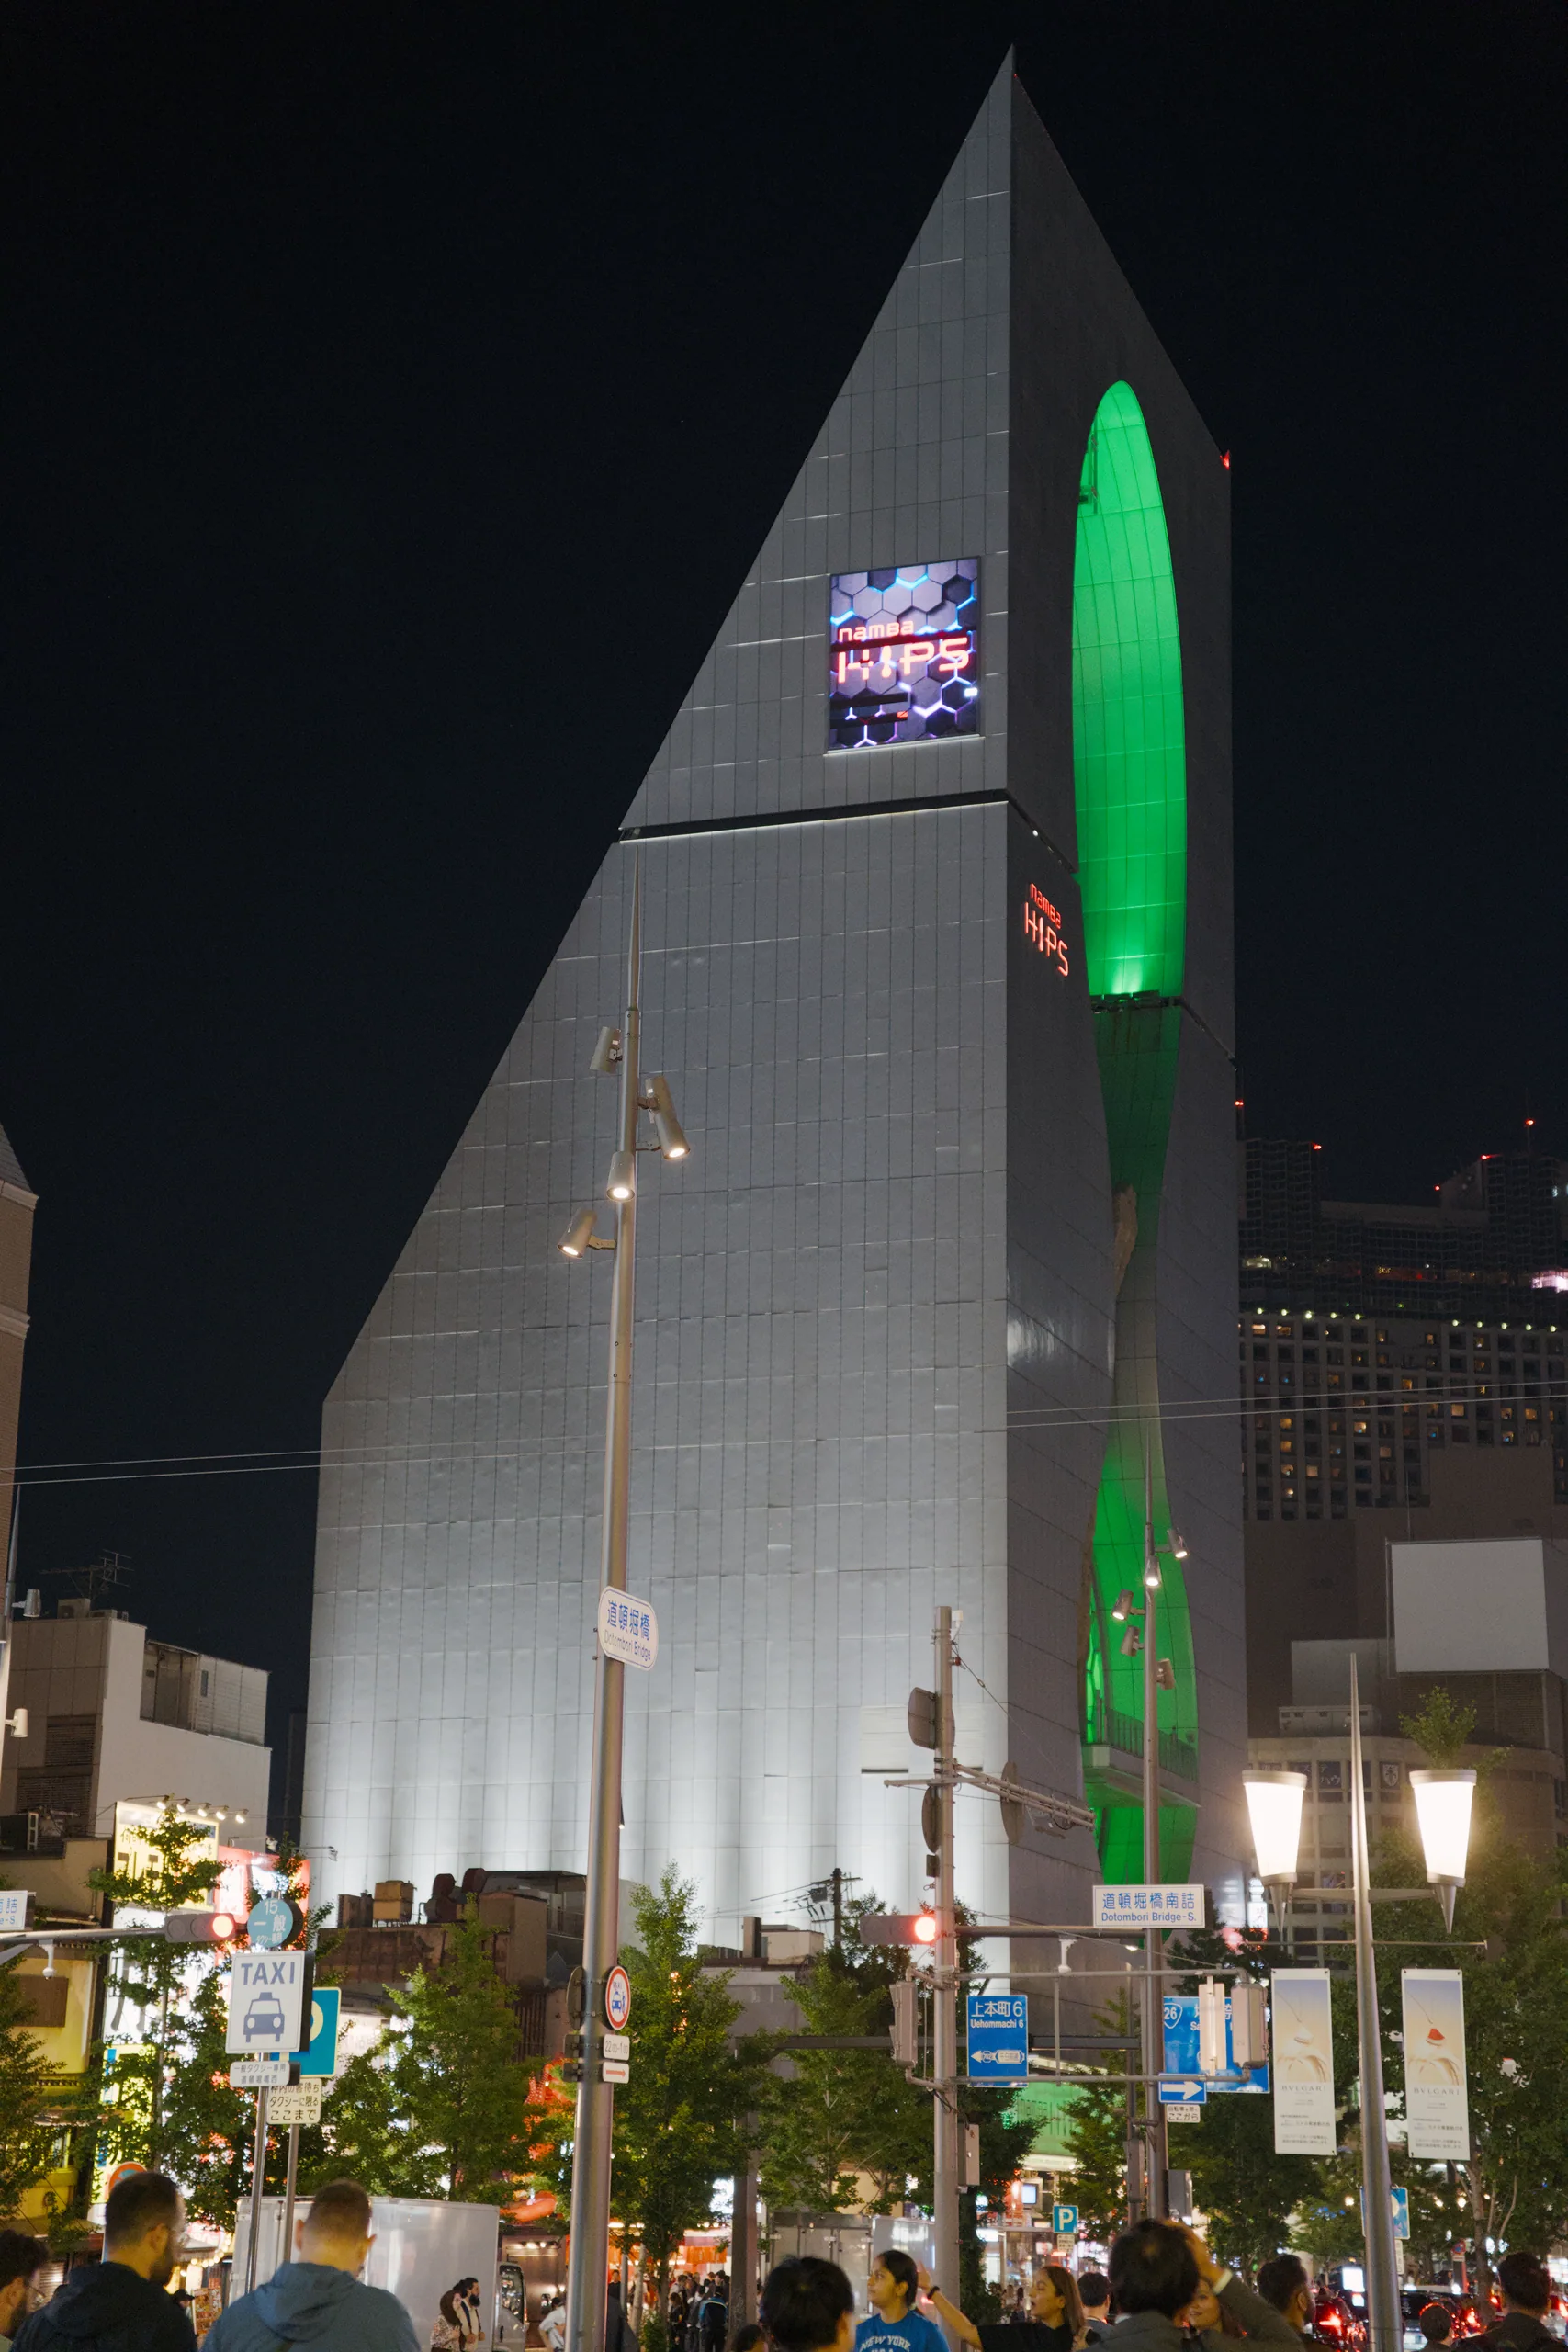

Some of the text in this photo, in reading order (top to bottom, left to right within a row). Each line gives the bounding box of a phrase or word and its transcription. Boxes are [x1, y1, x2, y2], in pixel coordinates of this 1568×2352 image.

[838, 637, 970, 684] HIPS
[1024, 901, 1068, 977] HIPS
[607, 1600, 650, 1641] 道頓堀橋
[264, 1899, 278, 1916] 15
[1102, 1892, 1195, 1910] 道頓堀橋南詰
[254, 1914, 287, 1933] 一般
[1101, 1912, 1148, 1922] Dotombori
[241, 1962, 296, 1985] TAXI
[1164, 2007, 1177, 2020] 26
[970, 2018, 1024, 2029] Uehommachi 6
[1413, 2087, 1460, 2096] BVLGARI
[269, 2096, 319, 2107] タクシーに限る
[270, 2109, 316, 2120] ここまで
[1168, 2112, 1199, 2121] ここから
[1059, 2208, 1073, 2231] P
[859, 2335, 911, 2352] NEW YORK
